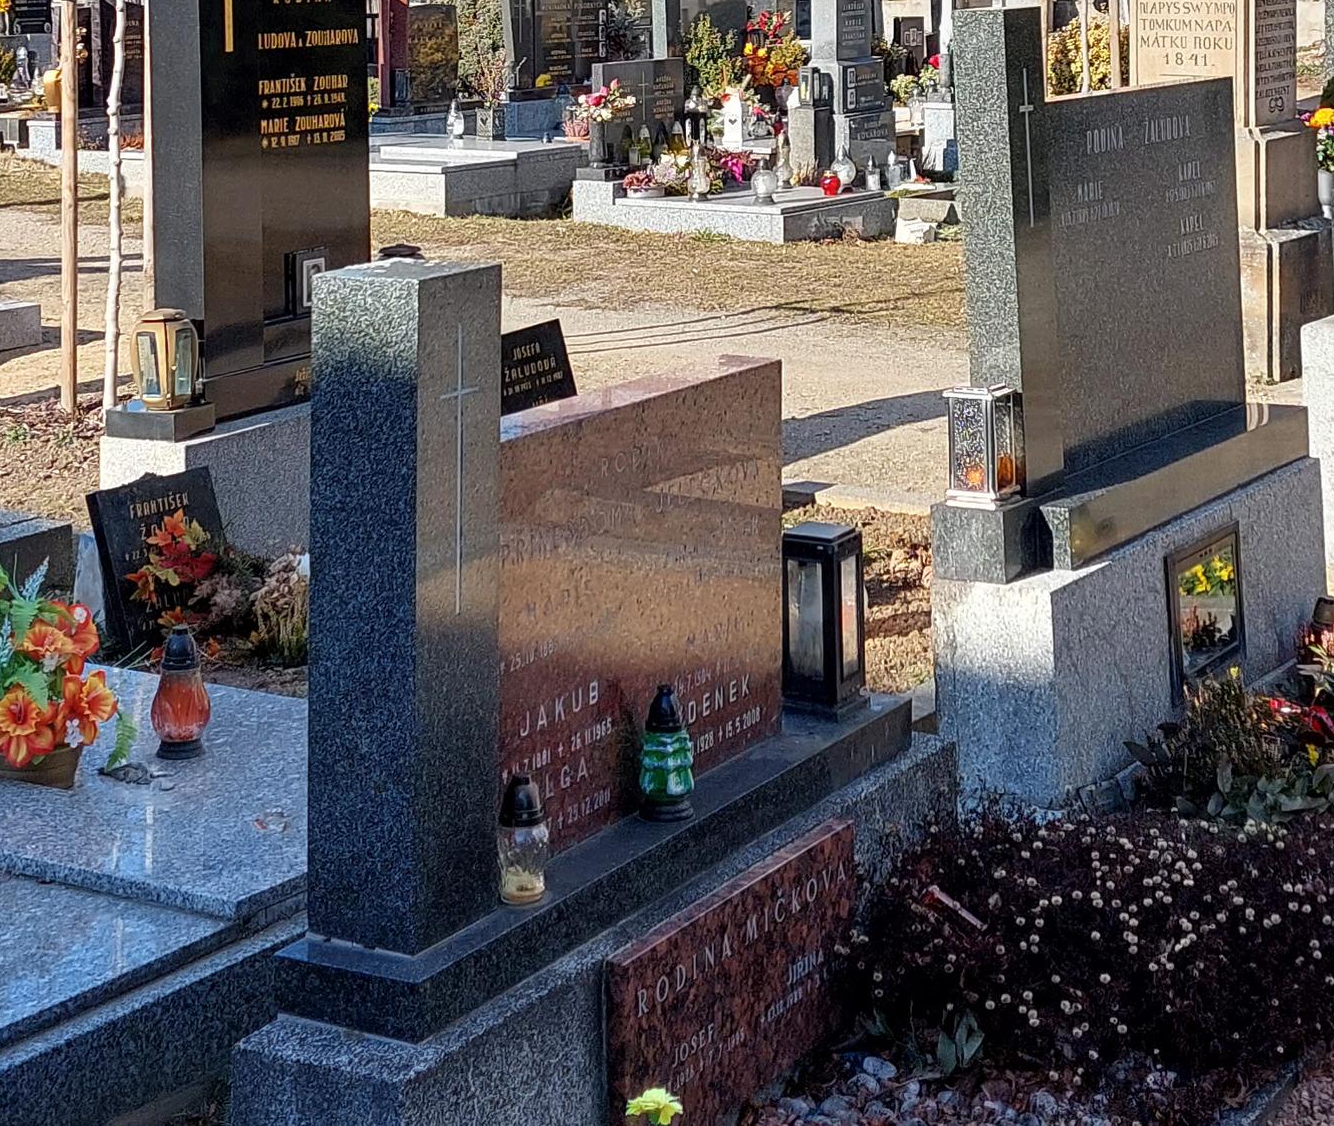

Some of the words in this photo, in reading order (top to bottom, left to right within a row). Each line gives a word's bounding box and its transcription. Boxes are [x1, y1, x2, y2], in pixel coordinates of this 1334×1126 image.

[258, 31, 296, 50] LUDOVA
[258, 73, 307, 95] FRANTIŠEK
[313, 74, 348, 91] ZOUHAR
[260, 117, 289, 134] MARIE
[295, 108, 345, 131] ZOUHAROVÁ
[129, 491, 190, 519] FRANTIŠEK
[520, 679, 599, 737] JAKUB
[545, 756, 589, 800] LGA
[637, 933, 731, 1019] RODINA
[745, 862, 846, 945] MIČKOVA
[787, 947, 825, 986] JIŘINA
[672, 1023, 715, 1068] JOSEF
